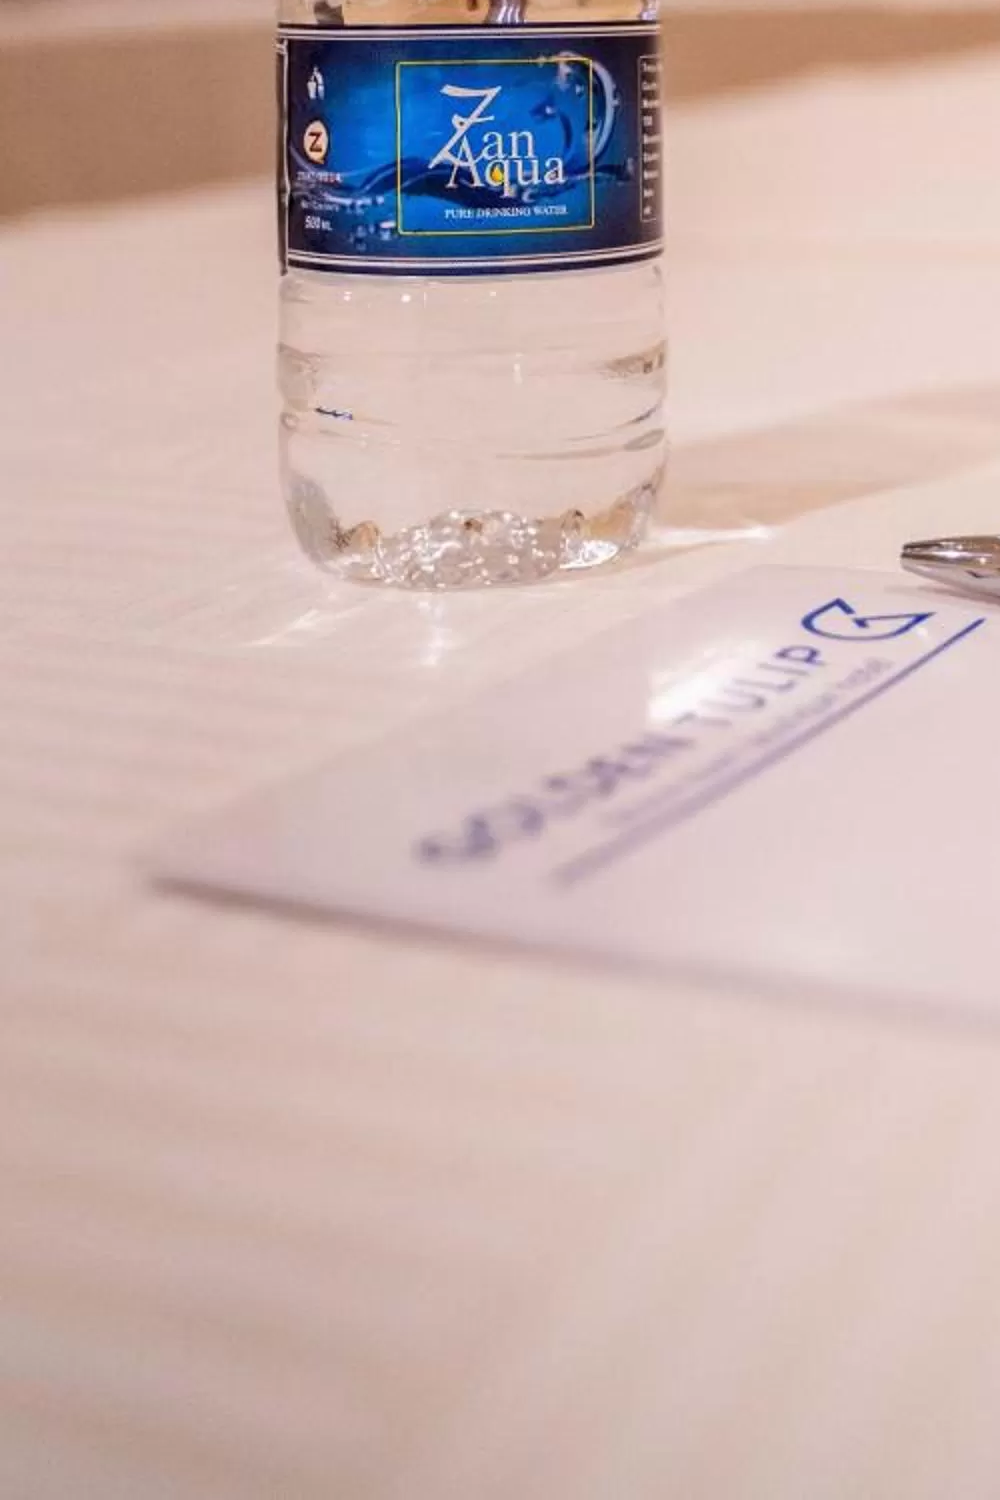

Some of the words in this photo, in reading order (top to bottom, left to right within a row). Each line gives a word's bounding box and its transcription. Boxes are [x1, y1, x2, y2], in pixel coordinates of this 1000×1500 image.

[428, 84, 537, 169] Zan
[445, 135, 567, 198] Aqua
[445, 208, 475, 219] PURE
[476, 206, 531, 218] DRINKING
[533, 204, 568, 216] WATER
[670, 645, 826, 727] TULIP
